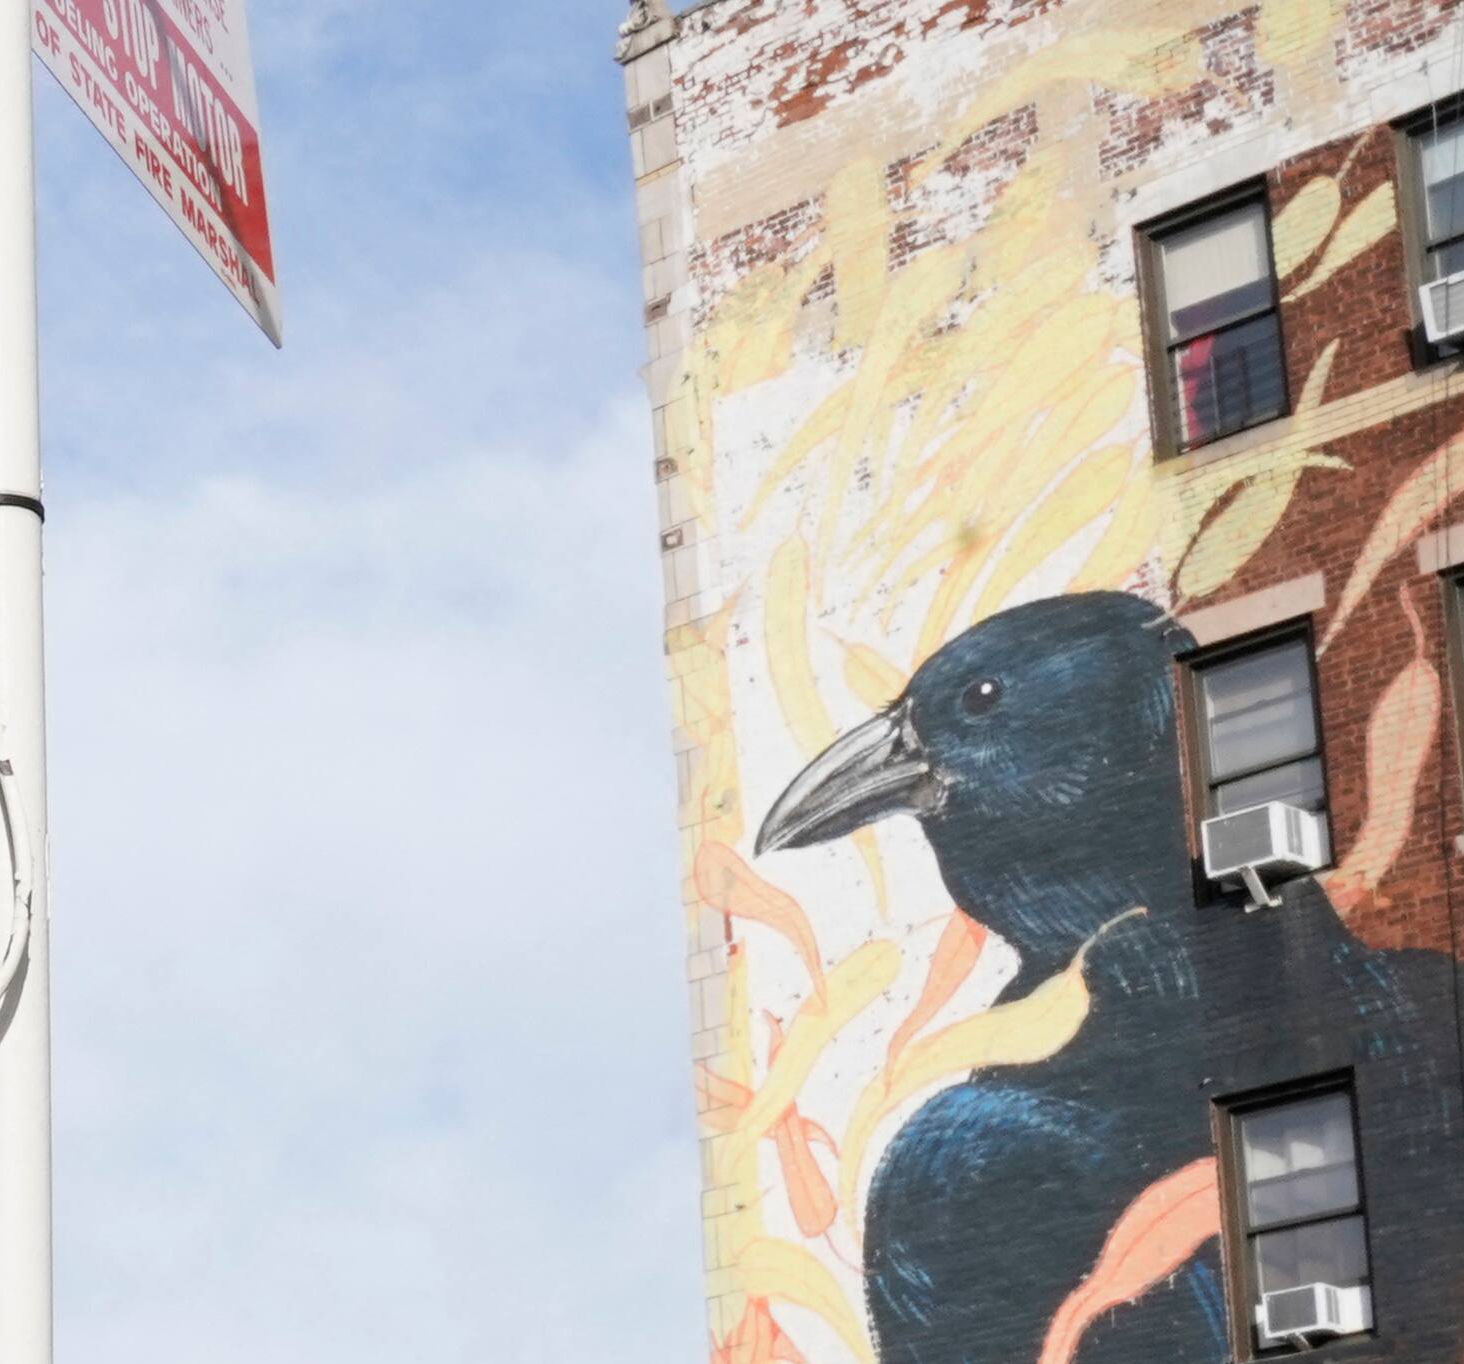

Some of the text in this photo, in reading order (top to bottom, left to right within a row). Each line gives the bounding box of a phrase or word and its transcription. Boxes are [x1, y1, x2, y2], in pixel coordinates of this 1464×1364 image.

[35, 10, 261, 309] OF STATE FIRE MARSHAL
[166, 34, 249, 207] MOTOR
